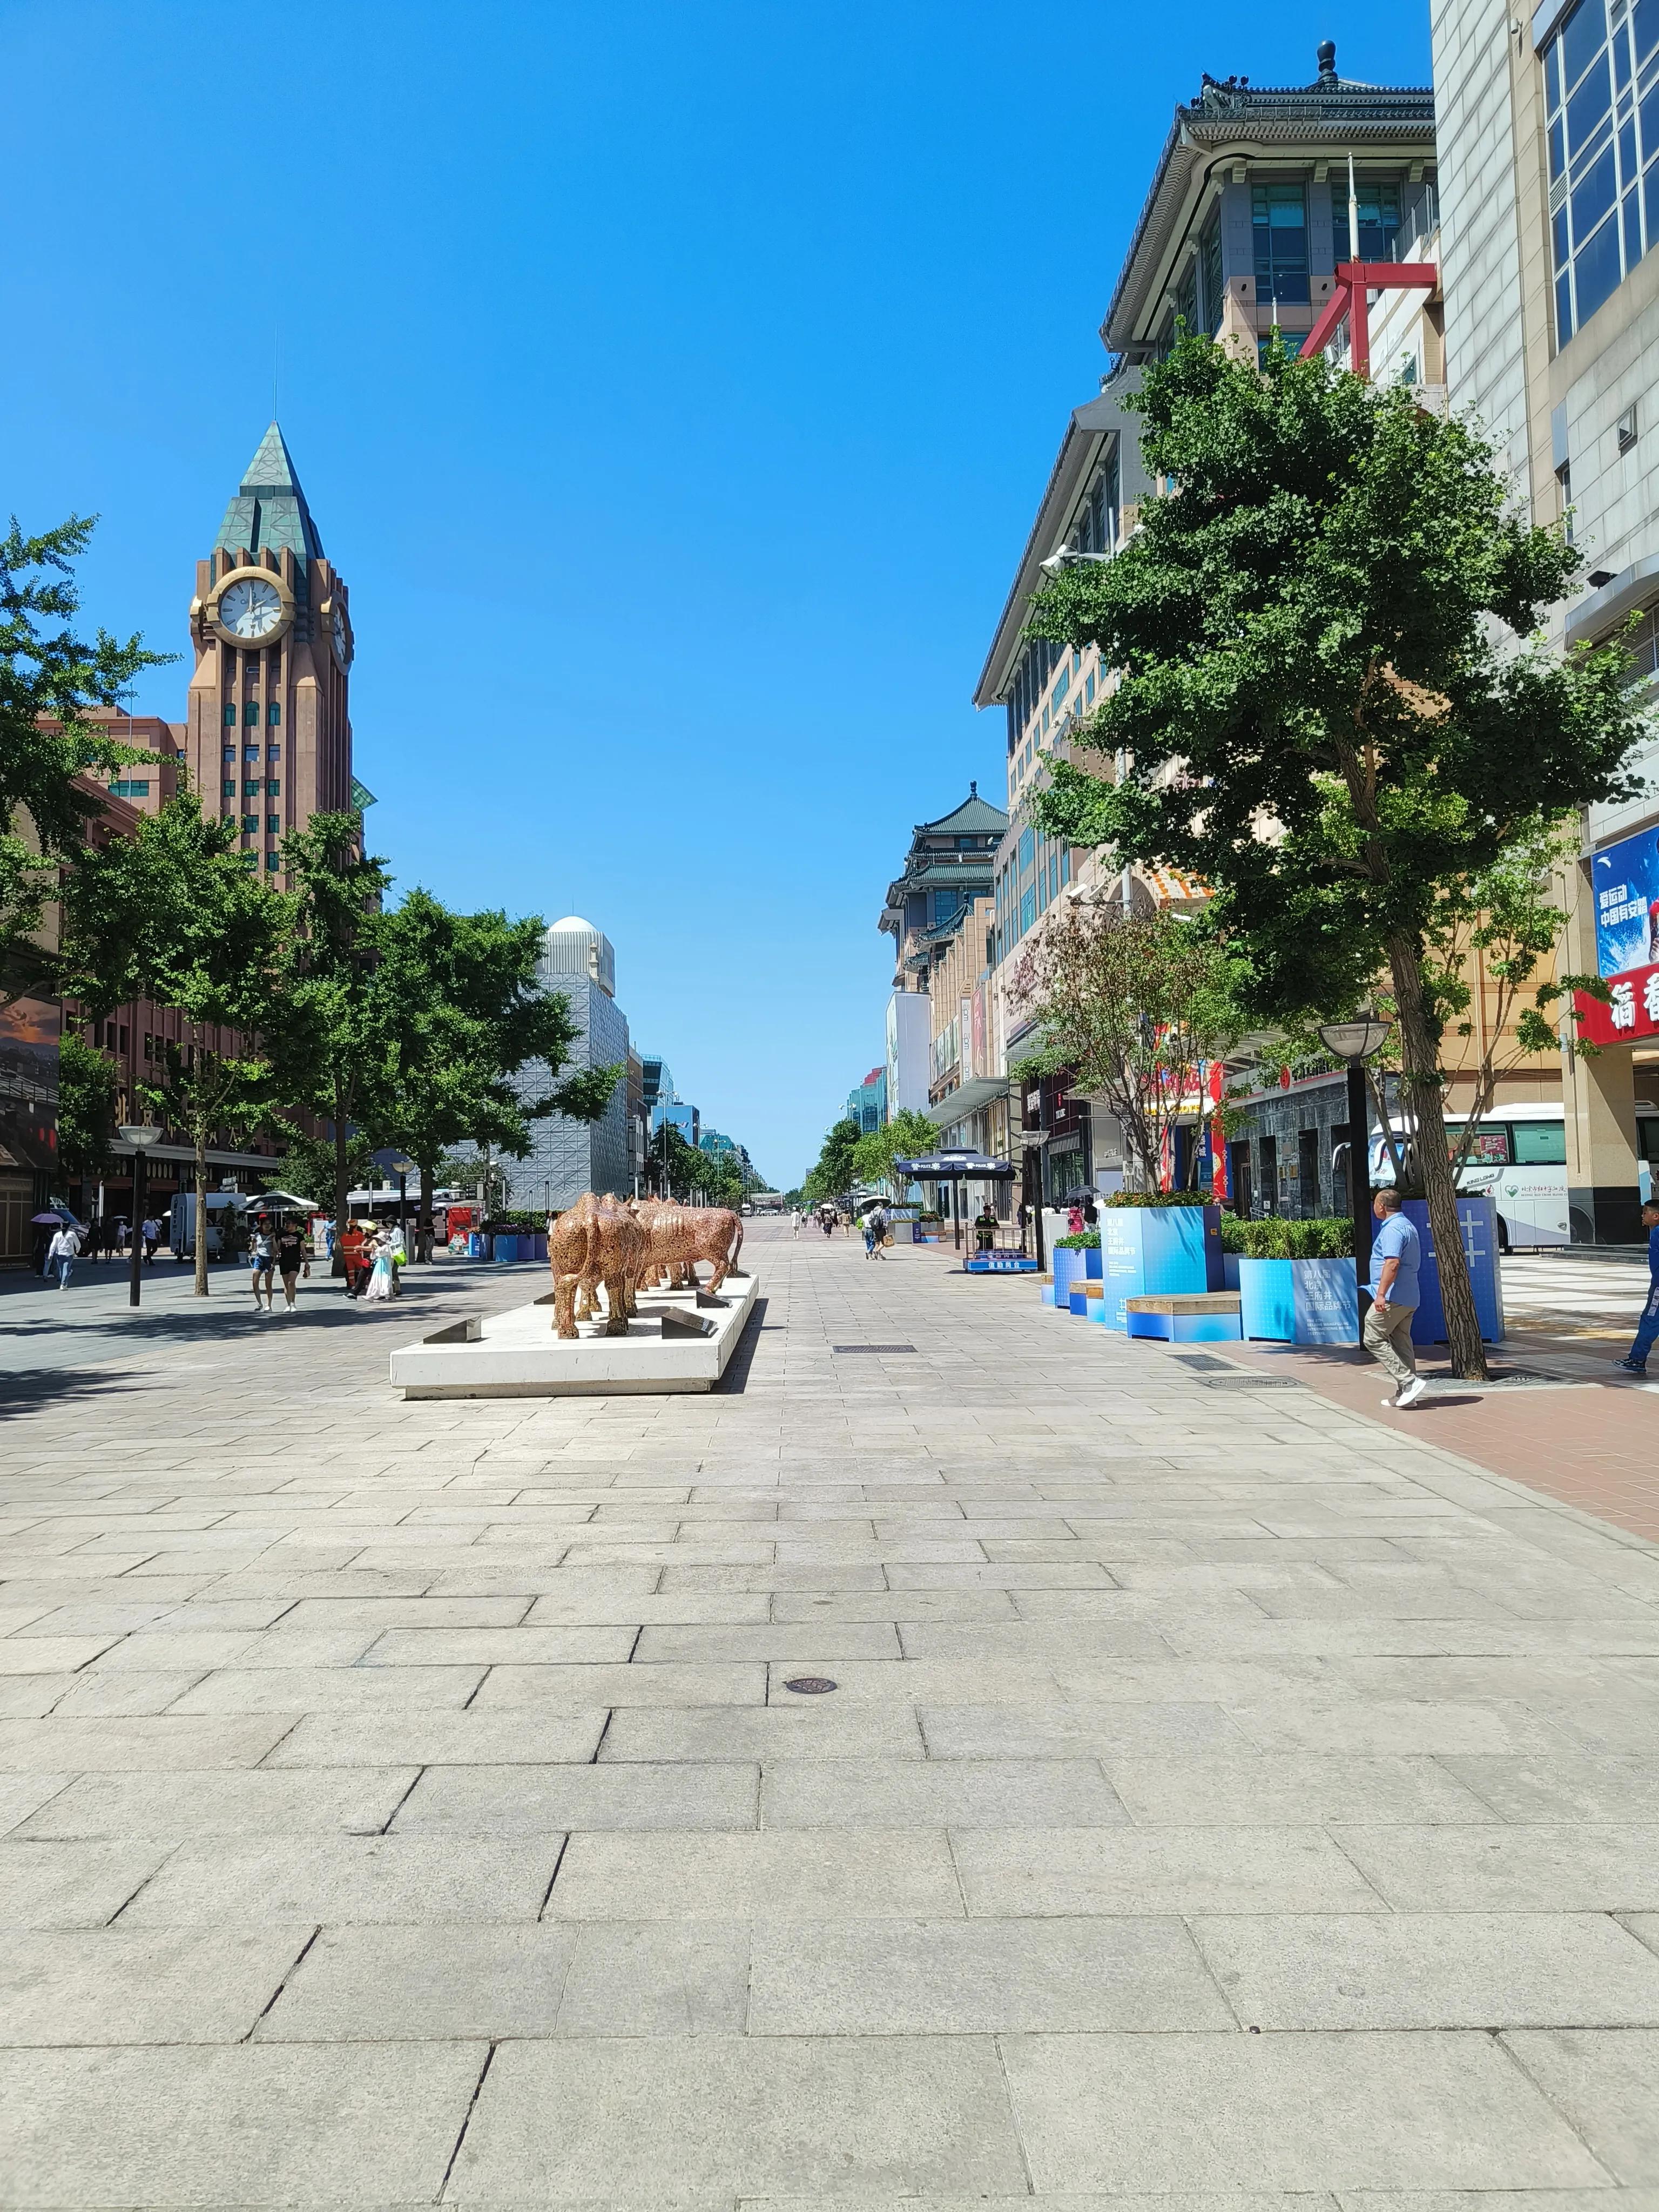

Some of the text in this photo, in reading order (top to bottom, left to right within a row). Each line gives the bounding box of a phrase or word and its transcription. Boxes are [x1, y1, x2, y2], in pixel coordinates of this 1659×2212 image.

[1600, 884, 1627, 909] 爱运动
[1601, 896, 1648, 928] 中国有安踏
[1304, 1269, 1331, 1279] 第八届
[1305, 1280, 1322, 1290] 北京
[1305, 1291, 1332, 1300] 王府井
[1306, 1300, 1351, 1311] 国际品牌节
